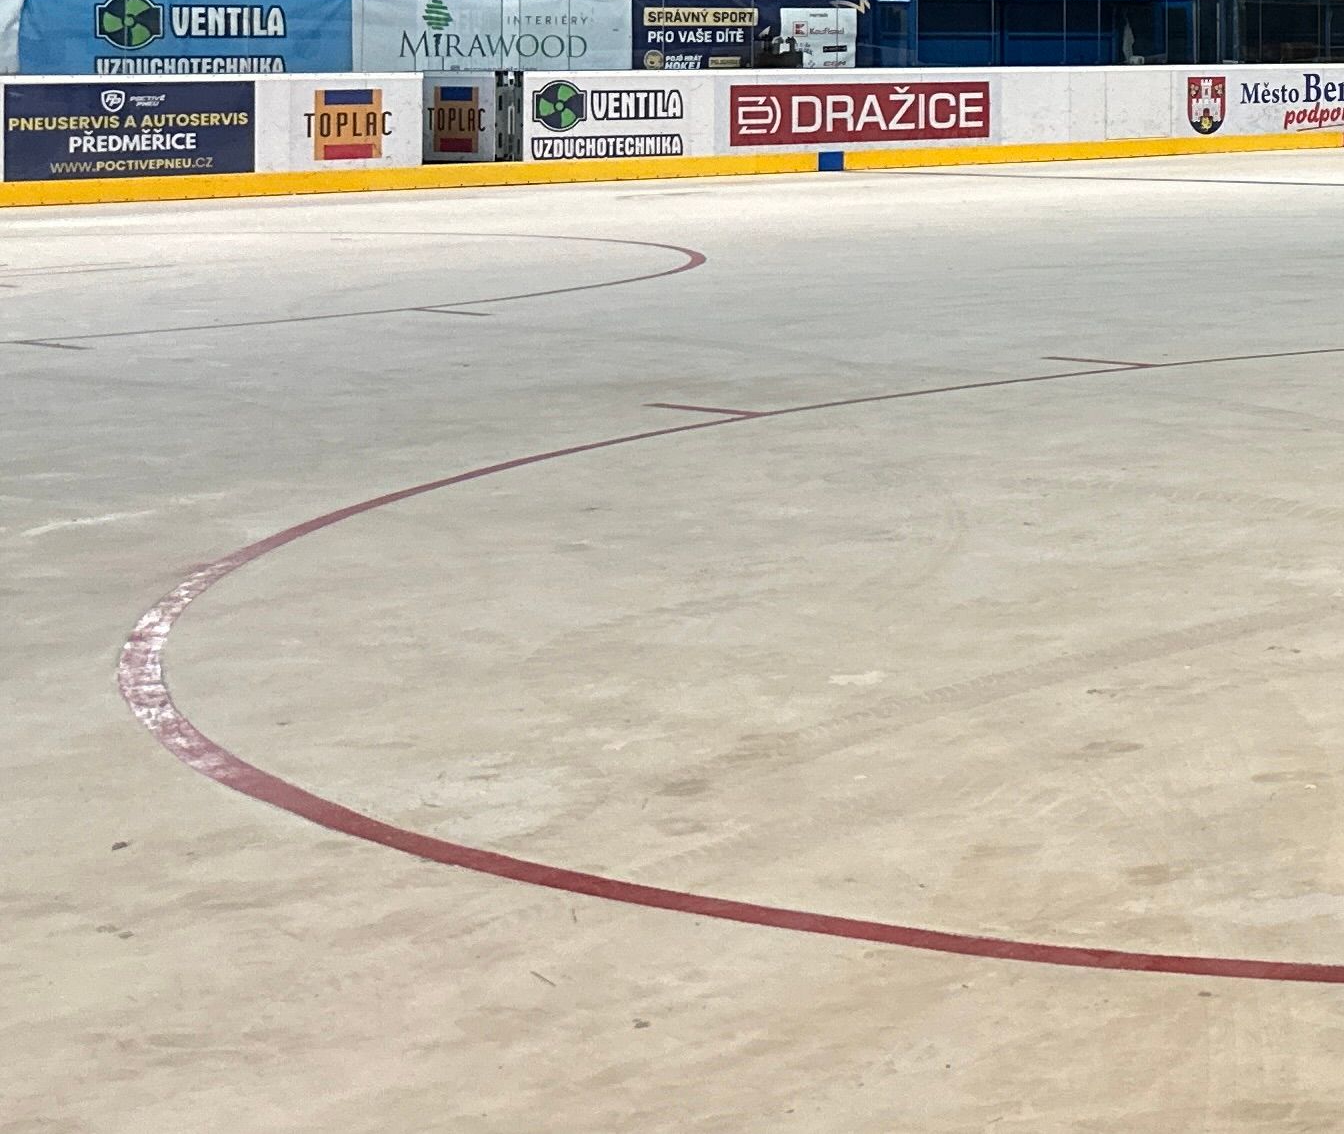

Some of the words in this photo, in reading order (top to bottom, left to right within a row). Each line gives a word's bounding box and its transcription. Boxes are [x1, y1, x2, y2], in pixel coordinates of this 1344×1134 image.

[170, 6, 285, 37] VENTILA
[507, 13, 588, 26] INTERIÉRY
[647, 8, 709, 23] SPRÁVNÝ
[712, 10, 755, 23] SPORT
[399, 29, 587, 58] MIRAWOOD
[647, 30, 675, 43] PRO
[677, 27, 713, 43] VAŠE
[716, 27, 744, 43] DÍTĚ
[665, 62, 701, 70] HOKEJ
[592, 90, 683, 119] VENTILA
[1240, 81, 1300, 105] Město
[8, 114, 120, 132] PNEUSERVIS
[124, 115, 137, 129] A
[141, 112, 249, 128] AUTOSERVIS
[427, 107, 486, 133] TOPLAC
[791, 86, 984, 134] DRAŽICE
[304, 111, 393, 138] TOPLAC
[69, 128, 197, 154] PŘEDMĚŘICE
[532, 134, 683, 159] VZDUCHOTECHNIKA
[50, 156, 214, 175] WWW.POCTIVEPNEU.CZ
